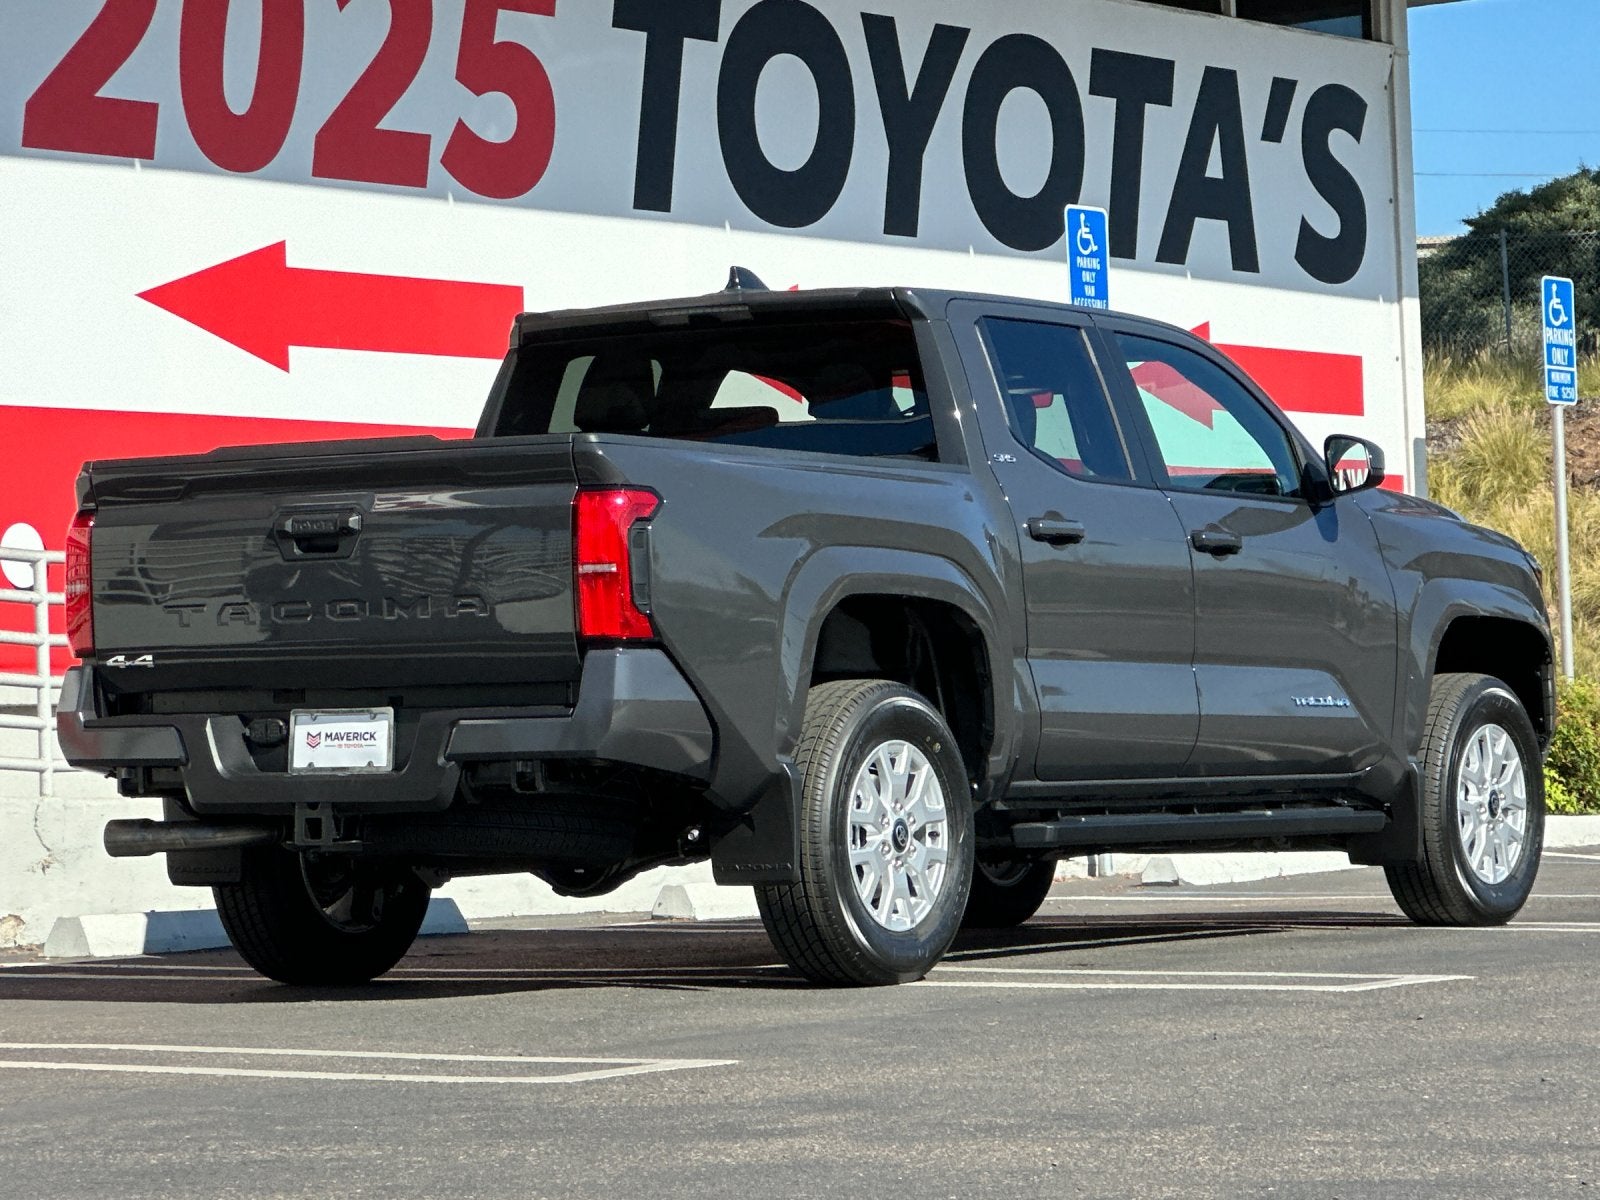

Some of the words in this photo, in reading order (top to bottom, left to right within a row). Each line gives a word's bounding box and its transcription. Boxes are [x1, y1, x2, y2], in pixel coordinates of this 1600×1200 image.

[22, 0, 556, 199] 2025
[612, 0, 1367, 285] TOYOTA'S
[1077, 256, 1100, 270] PARKING
[1082, 271, 1096, 283] ONLY
[1084, 284, 1096, 297] VAN
[1546, 327, 1573, 346] PARKING
[1552, 347, 1569, 365] ONLY
[162, 595, 490, 628] TACOMA
[1290, 695, 1351, 707] TACOMA
[325, 732, 376, 741] MAVERICK
